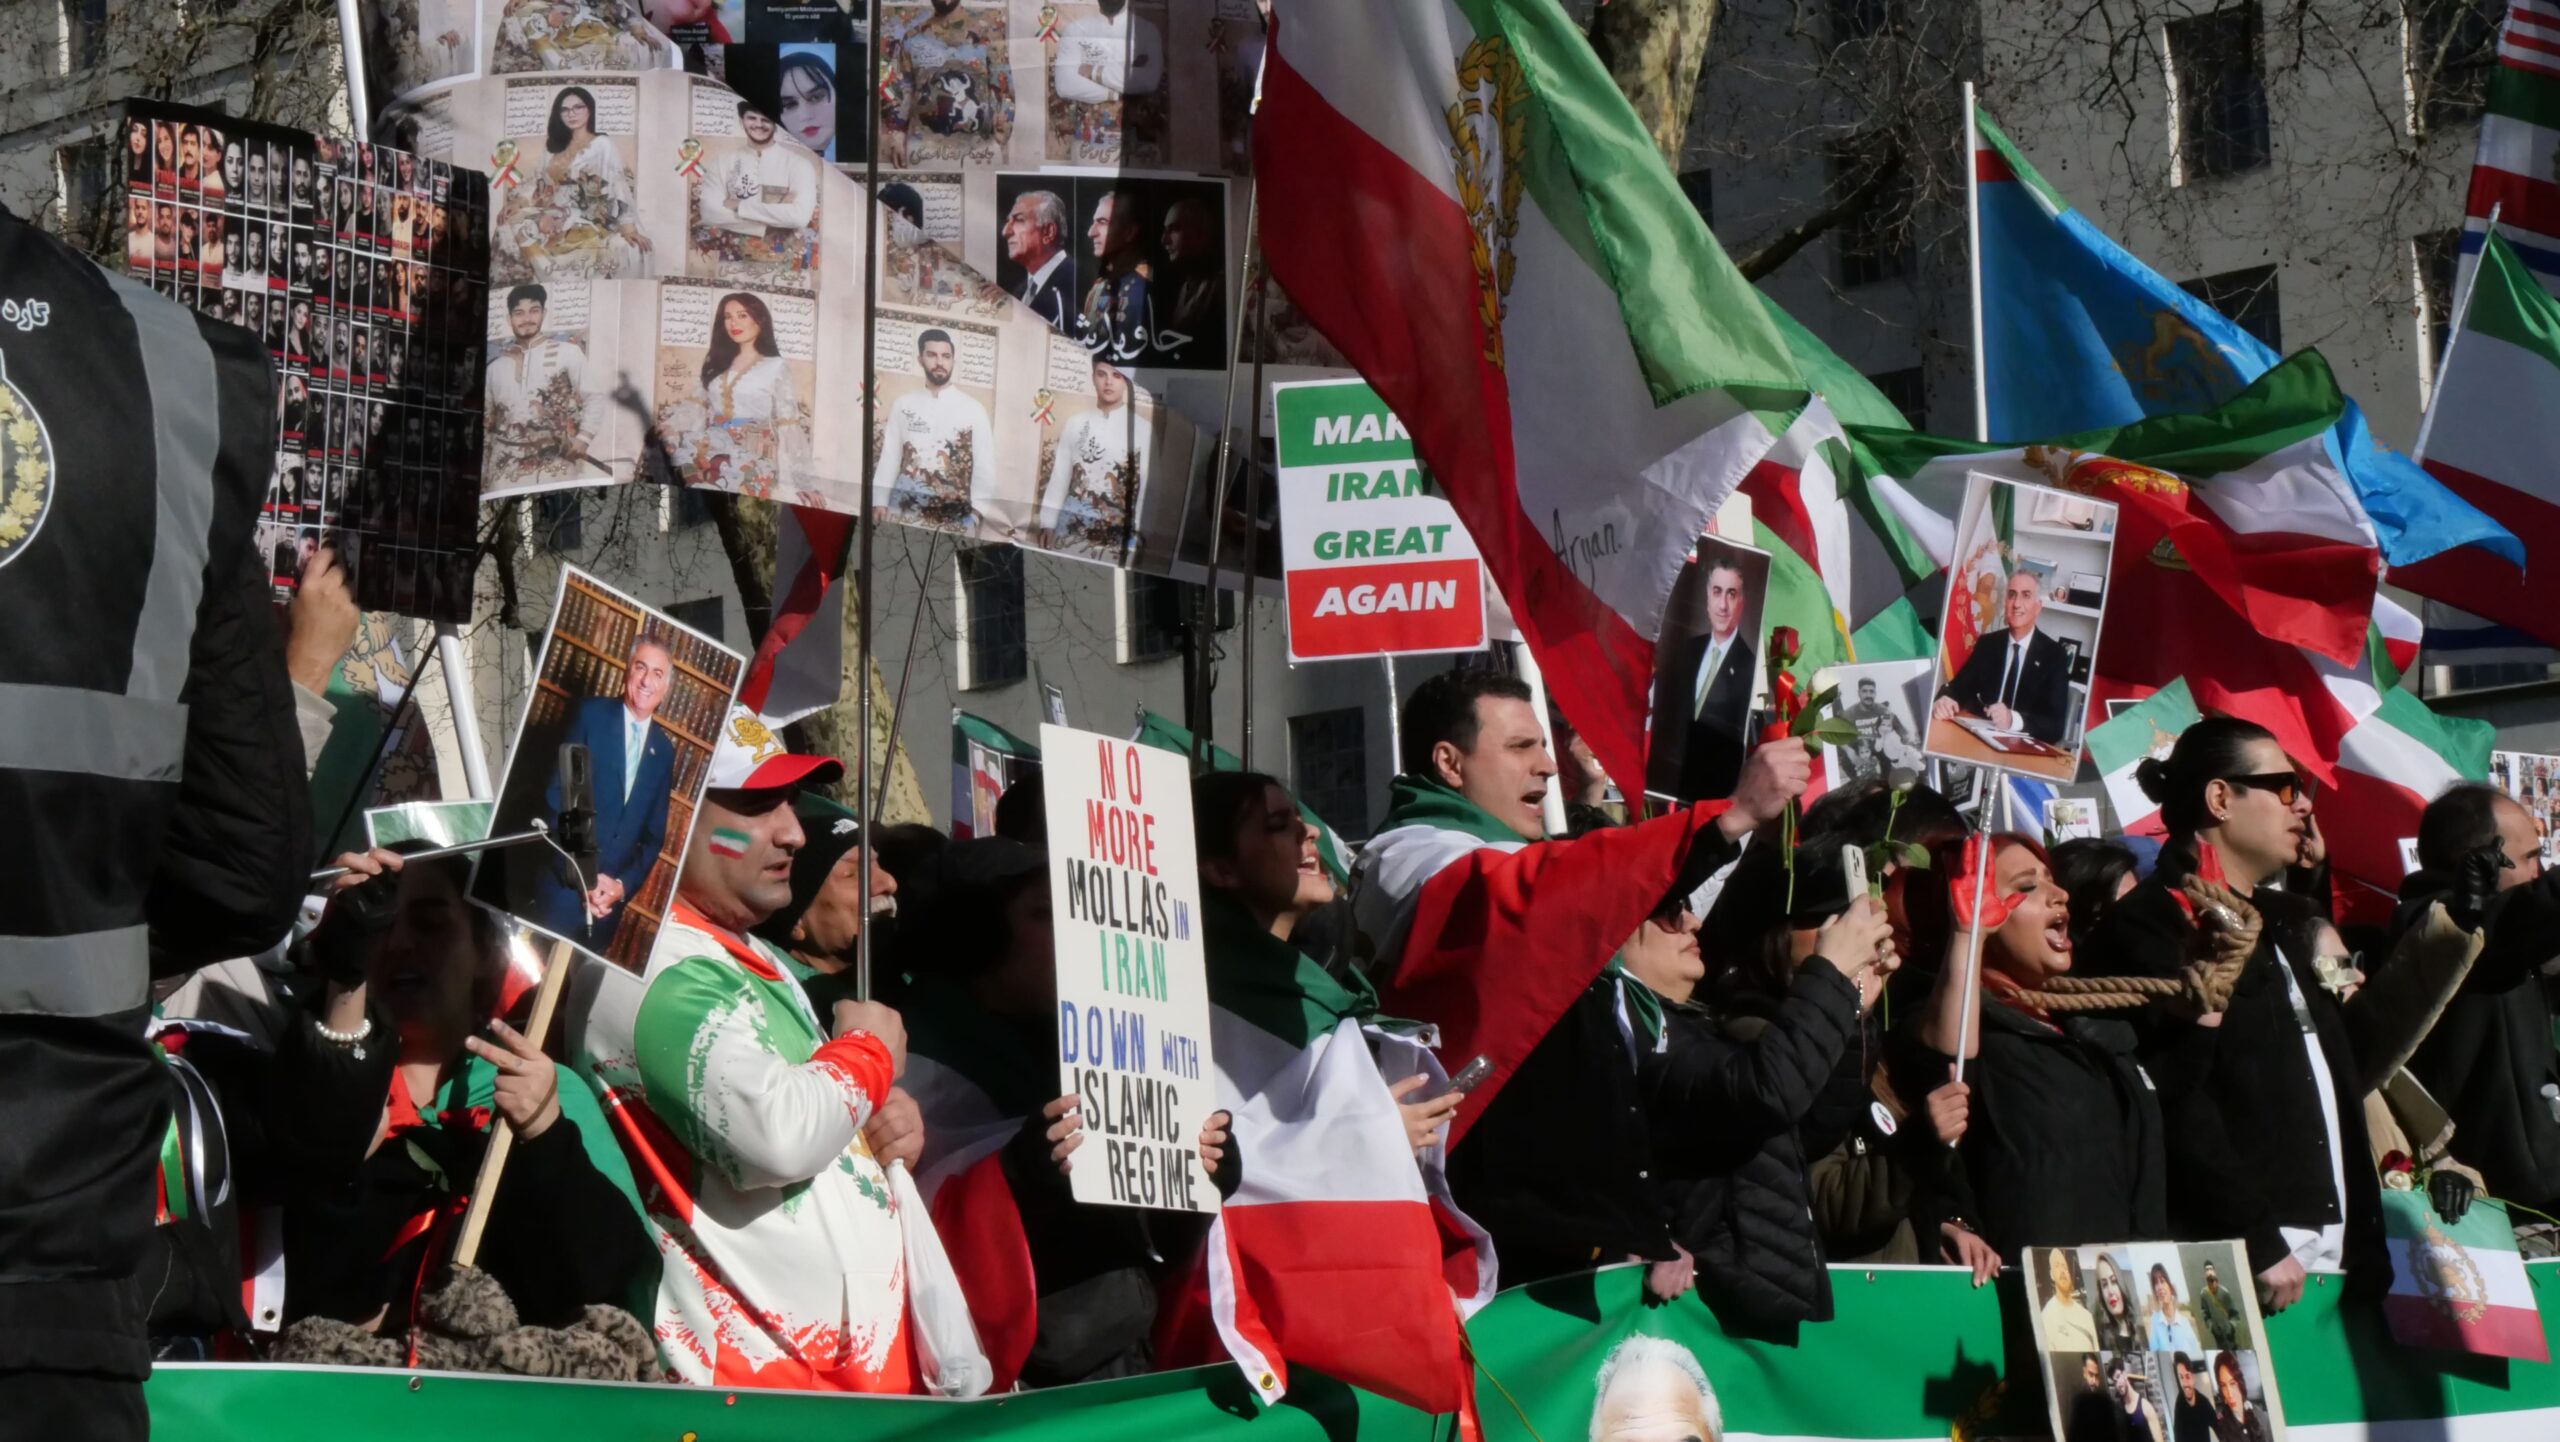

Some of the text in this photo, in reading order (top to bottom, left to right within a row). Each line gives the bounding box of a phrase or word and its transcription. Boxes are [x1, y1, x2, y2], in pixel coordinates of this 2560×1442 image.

[1312, 412, 1412, 446] MAK
[1313, 524, 1452, 561] GREAT
[1312, 579, 1457, 618] AGAIN
[1097, 739, 1144, 806] NO
[1086, 798, 1159, 877] MORE
[1066, 856, 1191, 942] MOLLAS IN
[1099, 929, 1168, 1003] IRAN
[1060, 1000, 1200, 1080] DOWN WITH
[1073, 1067, 1180, 1145] ISLAMIC
[1106, 1137, 1199, 1212] REGIME
